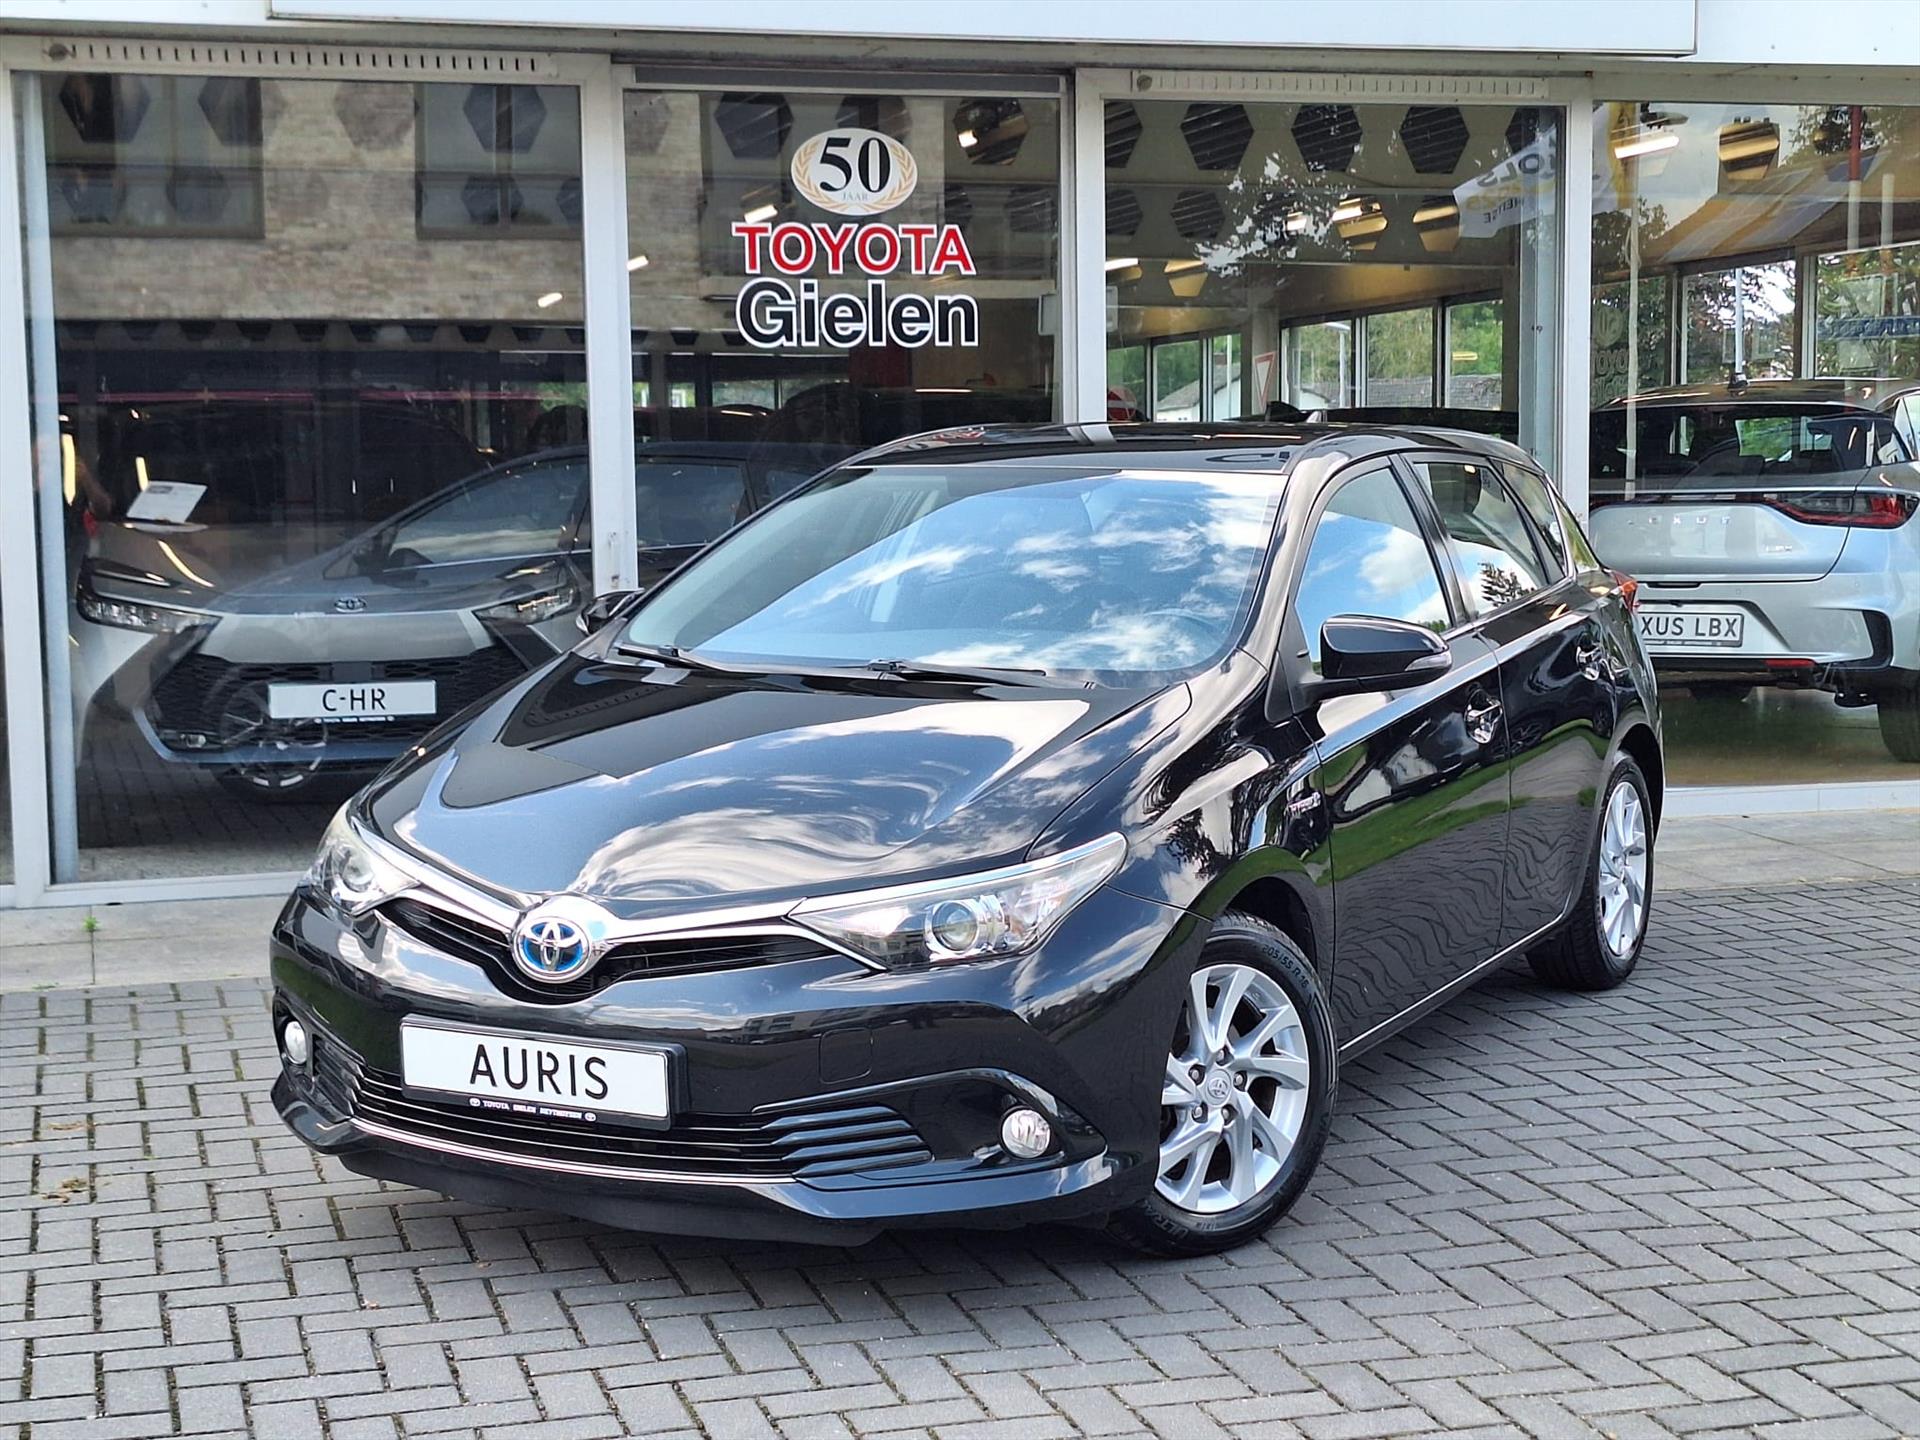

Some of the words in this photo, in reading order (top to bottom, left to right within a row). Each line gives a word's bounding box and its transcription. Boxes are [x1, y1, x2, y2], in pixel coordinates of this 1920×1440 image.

[819, 137, 891, 192] 50
[732, 222, 976, 275] TOYOTA
[735, 277, 979, 348] Gielen
[1641, 616, 1684, 636] XUS
[1695, 617, 1737, 637] LBX
[322, 688, 386, 712] C-HR
[470, 1043, 608, 1100] AURIS
